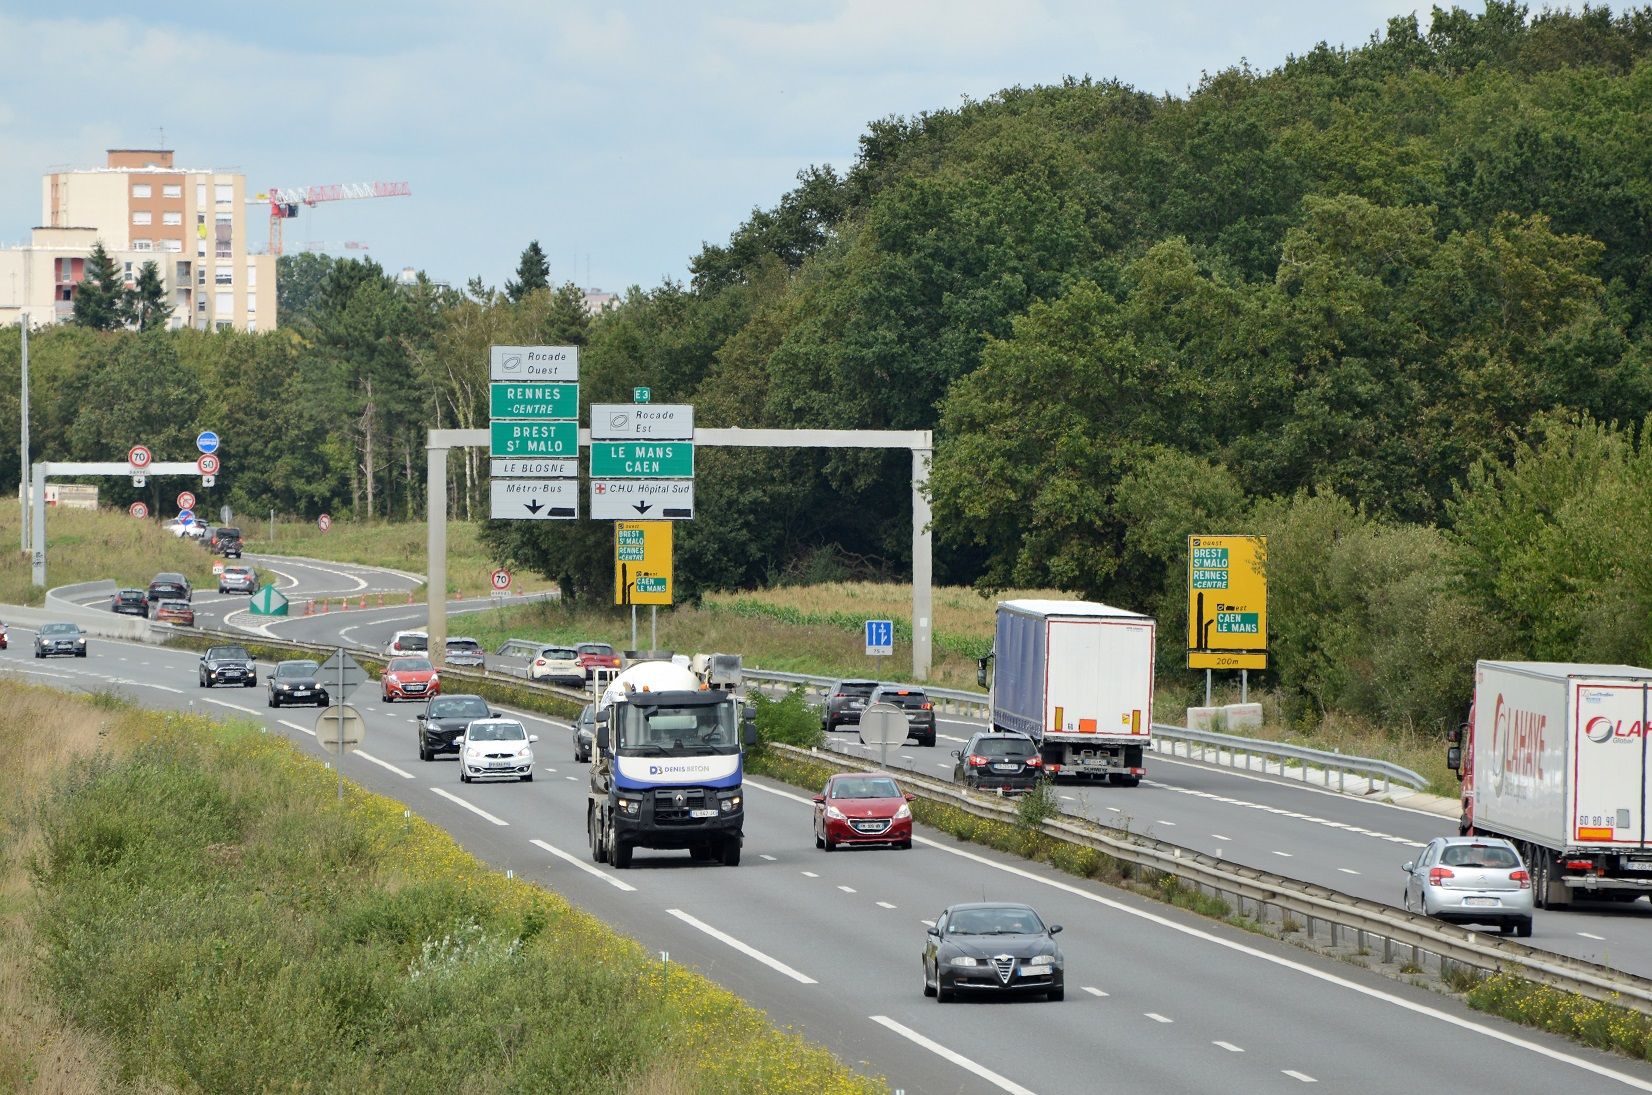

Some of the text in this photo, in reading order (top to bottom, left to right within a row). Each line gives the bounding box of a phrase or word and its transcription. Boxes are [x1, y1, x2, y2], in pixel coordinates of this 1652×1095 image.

[528, 352, 566, 361] Rocade
[527, 366, 558, 374] Ouest
[507, 388, 561, 400] RENNES
[507, 404, 553, 414] -CENTRE
[636, 411, 674, 420] Rocade
[513, 426, 556, 437] BREST
[636, 424, 652, 433] Est
[528, 441, 563, 451] MALO
[134, 453, 145, 461] 70
[611, 447, 673, 458] LE MANS
[202, 460, 214, 469] 50
[504, 464, 565, 473] LE BLOSNE
[625, 461, 660, 473] CAEN
[638, 485, 669, 494] Hôpital
[672, 485, 690, 494] Sud
[1194, 549, 1222, 558] BREST
[1204, 559, 1228, 568] MALO
[496, 575, 506, 584] 70
[1193, 570, 1228, 580] RENNES
[1218, 614, 1241, 622] CAEN
[1217, 624, 1257, 632] LE MANS
[1506, 707, 1546, 781] LAHAYE
[1579, 815, 1615, 827] 60 80 90
